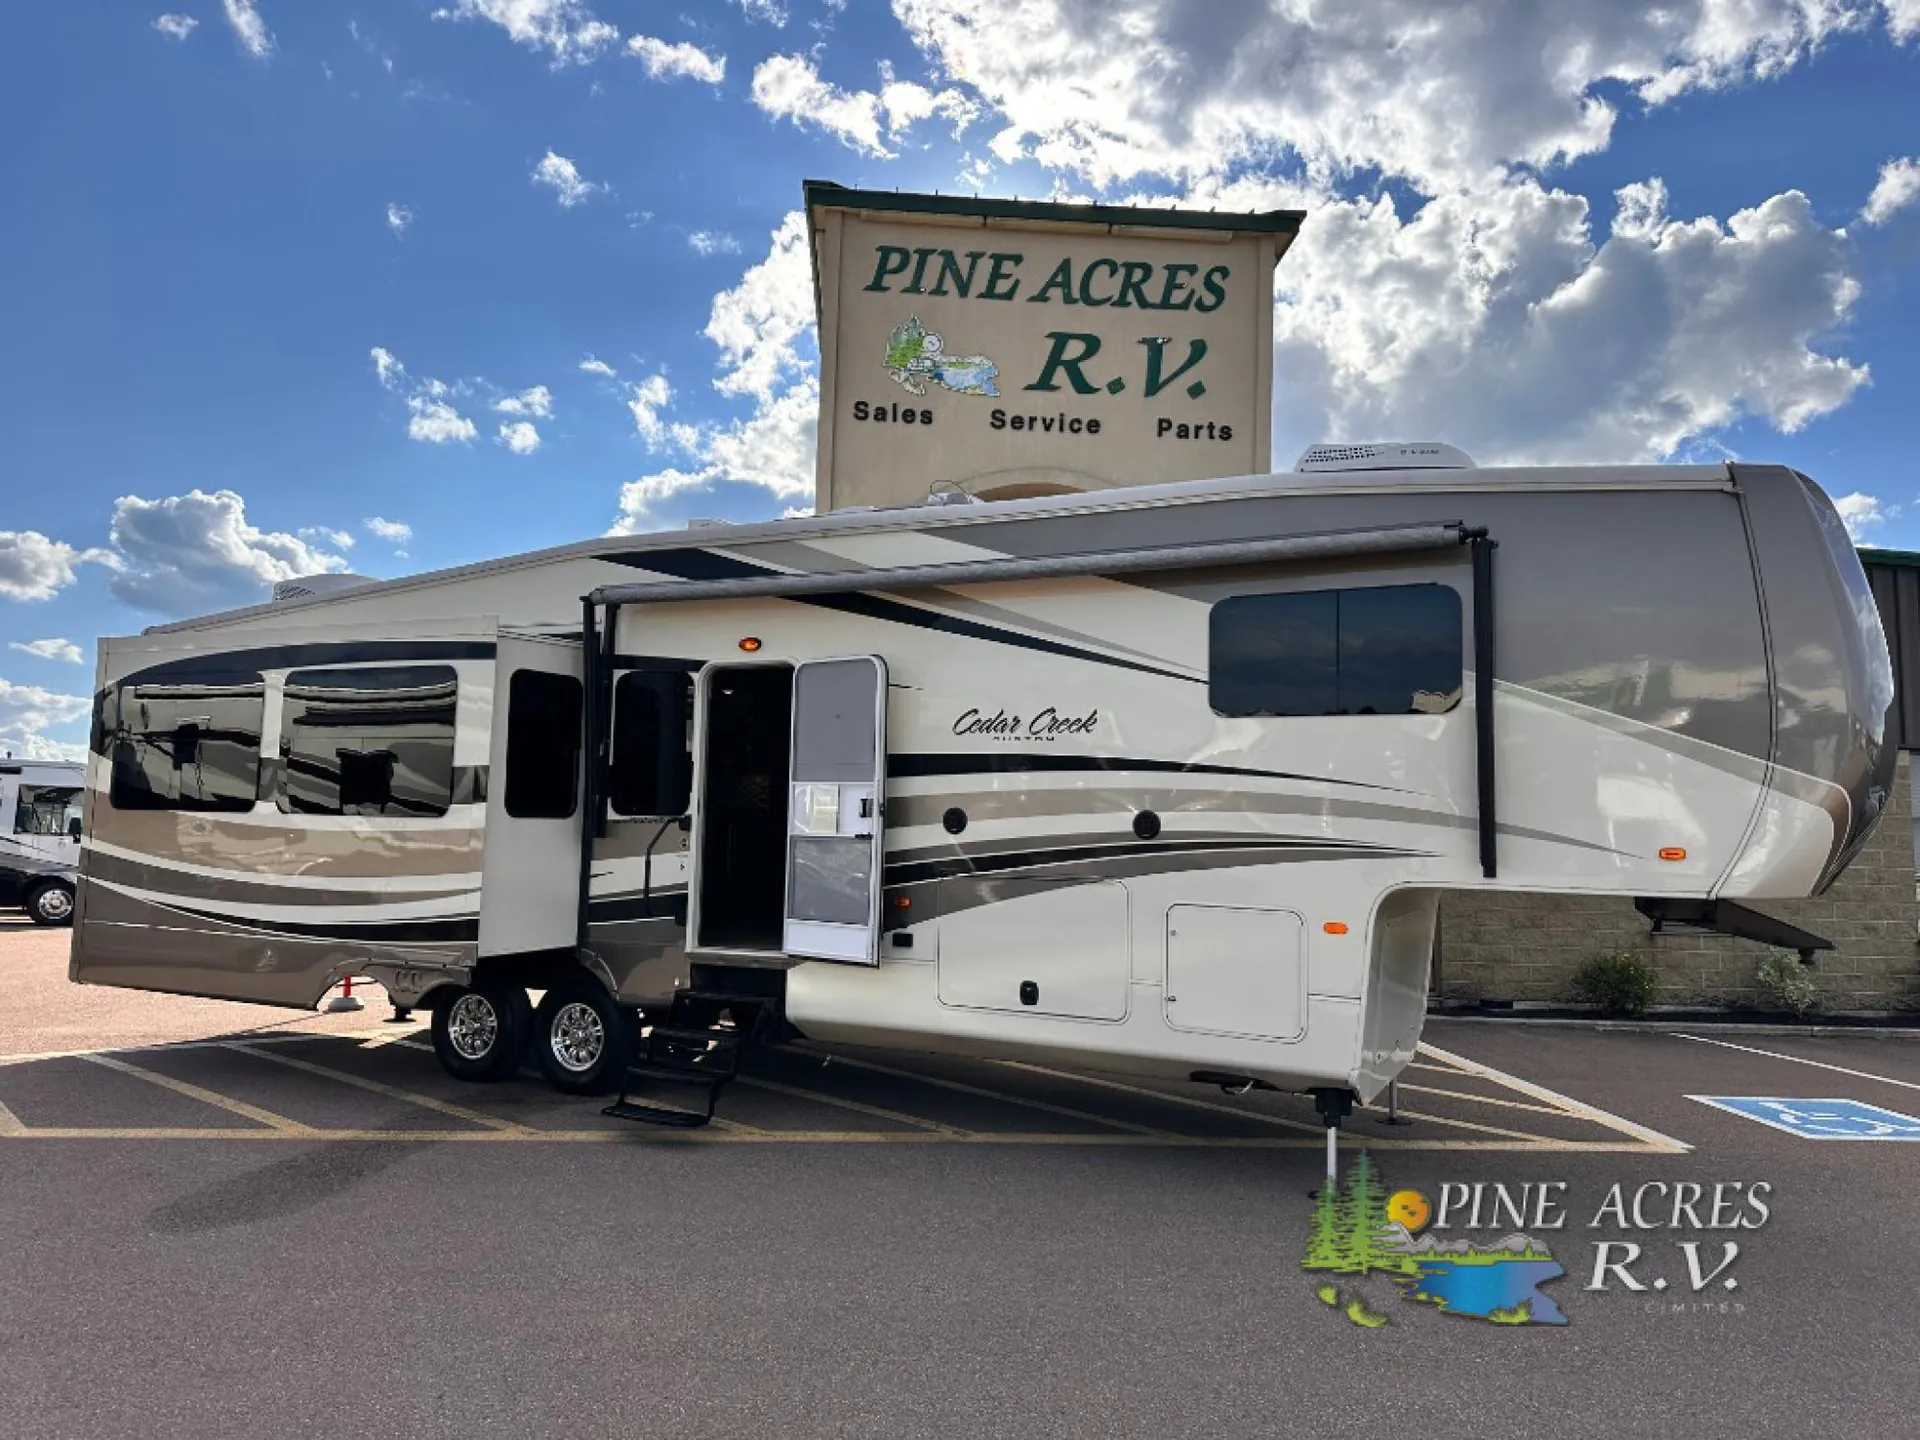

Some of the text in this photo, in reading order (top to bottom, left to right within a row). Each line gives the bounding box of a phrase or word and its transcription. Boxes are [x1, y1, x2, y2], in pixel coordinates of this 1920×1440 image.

[863, 244, 1231, 313] PINE ACRES
[1022, 331, 1208, 400] R.V.
[853, 401, 934, 425] Sales
[990, 409, 1102, 434] Service
[1156, 418, 1233, 442] Parts
[952, 706, 1098, 736] Cedar Creek
